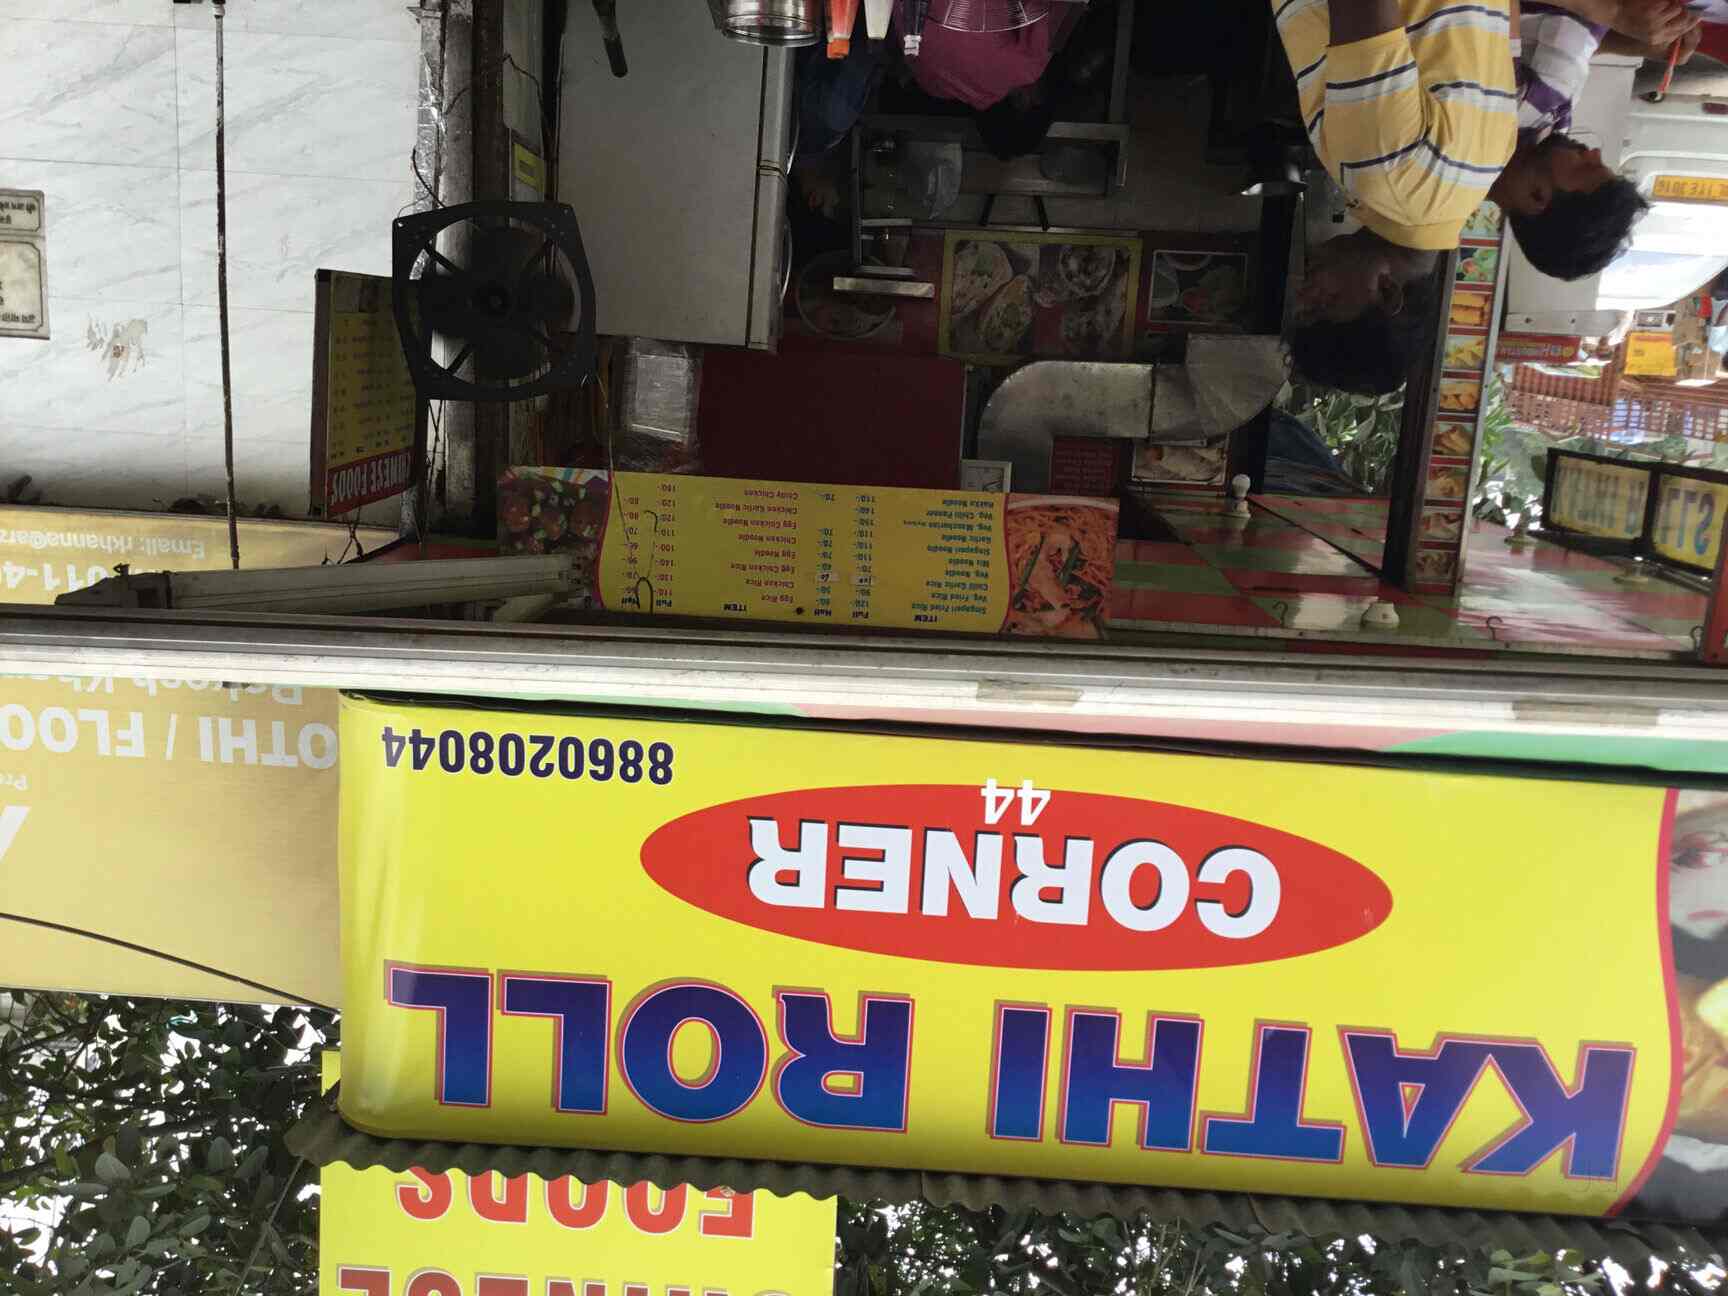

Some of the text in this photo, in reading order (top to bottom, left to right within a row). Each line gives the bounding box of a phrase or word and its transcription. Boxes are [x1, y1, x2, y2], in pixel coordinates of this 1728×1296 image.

[330, 464, 367, 506] FOODS
[744, 490, 775, 499] Chicken
[715, 503, 797, 514] Chicken Garlic Noodle
[942, 499, 994, 509] Hakka Noodle
[955, 511, 974, 520] Chilli
[723, 518, 796, 529] Egg Chicken Noodle
[929, 523, 973, 531] Manchurian
[976, 523, 992, 532] Veg.
[738, 534, 796, 544] Chicken Noodle
[941, 534, 991, 544] Garlic Noodle
[139, 537, 205, 560] Email:
[927, 545, 953, 554] Noodle
[754, 550, 795, 559] Egg Noodle
[948, 558, 989, 568] Mix Noodle
[749, 564, 779, 573] Chicken
[781, 565, 794, 574] Egg
[0, 561, 108, 592] 011-4
[945, 570, 989, 579] Veg. Noodle
[745, 579, 794, 589] Chicken Rice
[945, 581, 966, 590] Garlic
[761, 595, 793, 604] Egg Rice
[931, 592, 948, 600] Rice
[950, 593, 969, 601] Fried
[723, 604, 746, 612] ITEM
[930, 604, 949, 613] Fried
[814, 609, 832, 617] Half
[852, 611, 869, 619] Full
[914, 615, 937, 623] ITEM
[0, 704, 145, 757] FLOO
[198, 715, 338, 770] OTHI
[381, 726, 675, 785] 8860208044
[980, 777, 1051, 825] 44
[746, 817, 1281, 939] CORNER
[386, 962, 1635, 1180] KATHI ROLL
